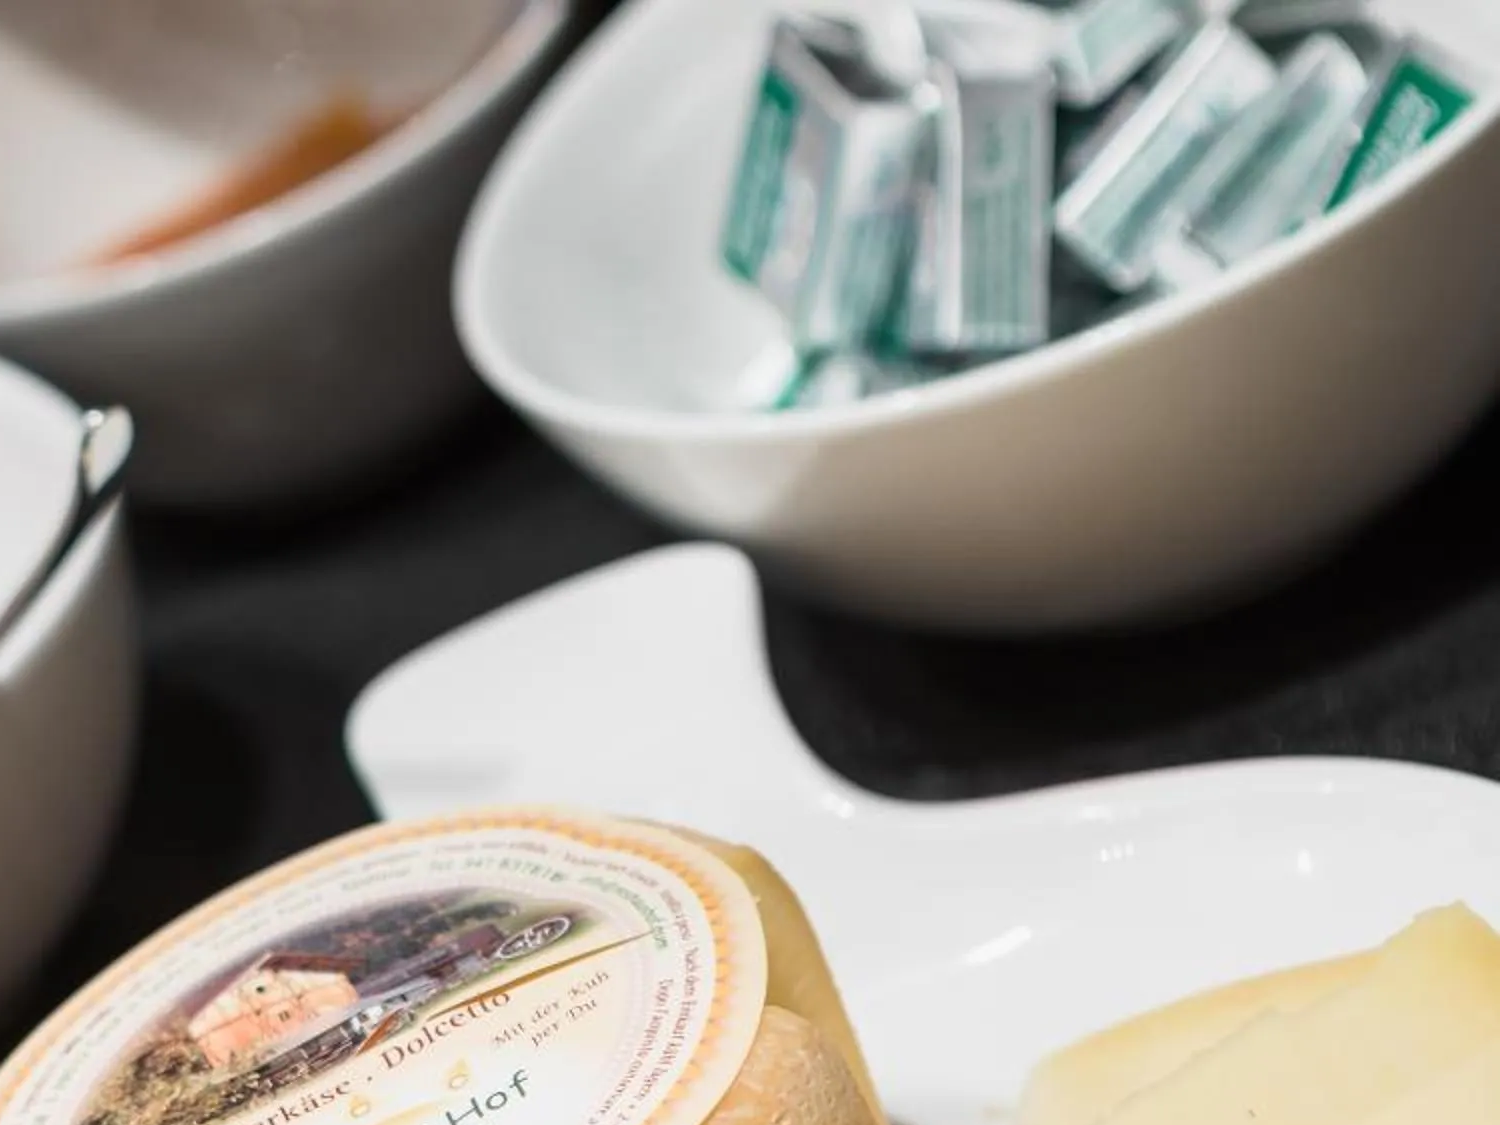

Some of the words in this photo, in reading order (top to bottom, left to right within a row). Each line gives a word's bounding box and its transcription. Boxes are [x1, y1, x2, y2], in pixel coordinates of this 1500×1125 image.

[381, 990, 511, 1071] Dolcetto
[493, 1018, 530, 1048] Mit
[531, 999, 561, 1023] der
[567, 970, 610, 1001] Kuh
[531, 1020, 562, 1049] per
[567, 999, 600, 1026] Du
